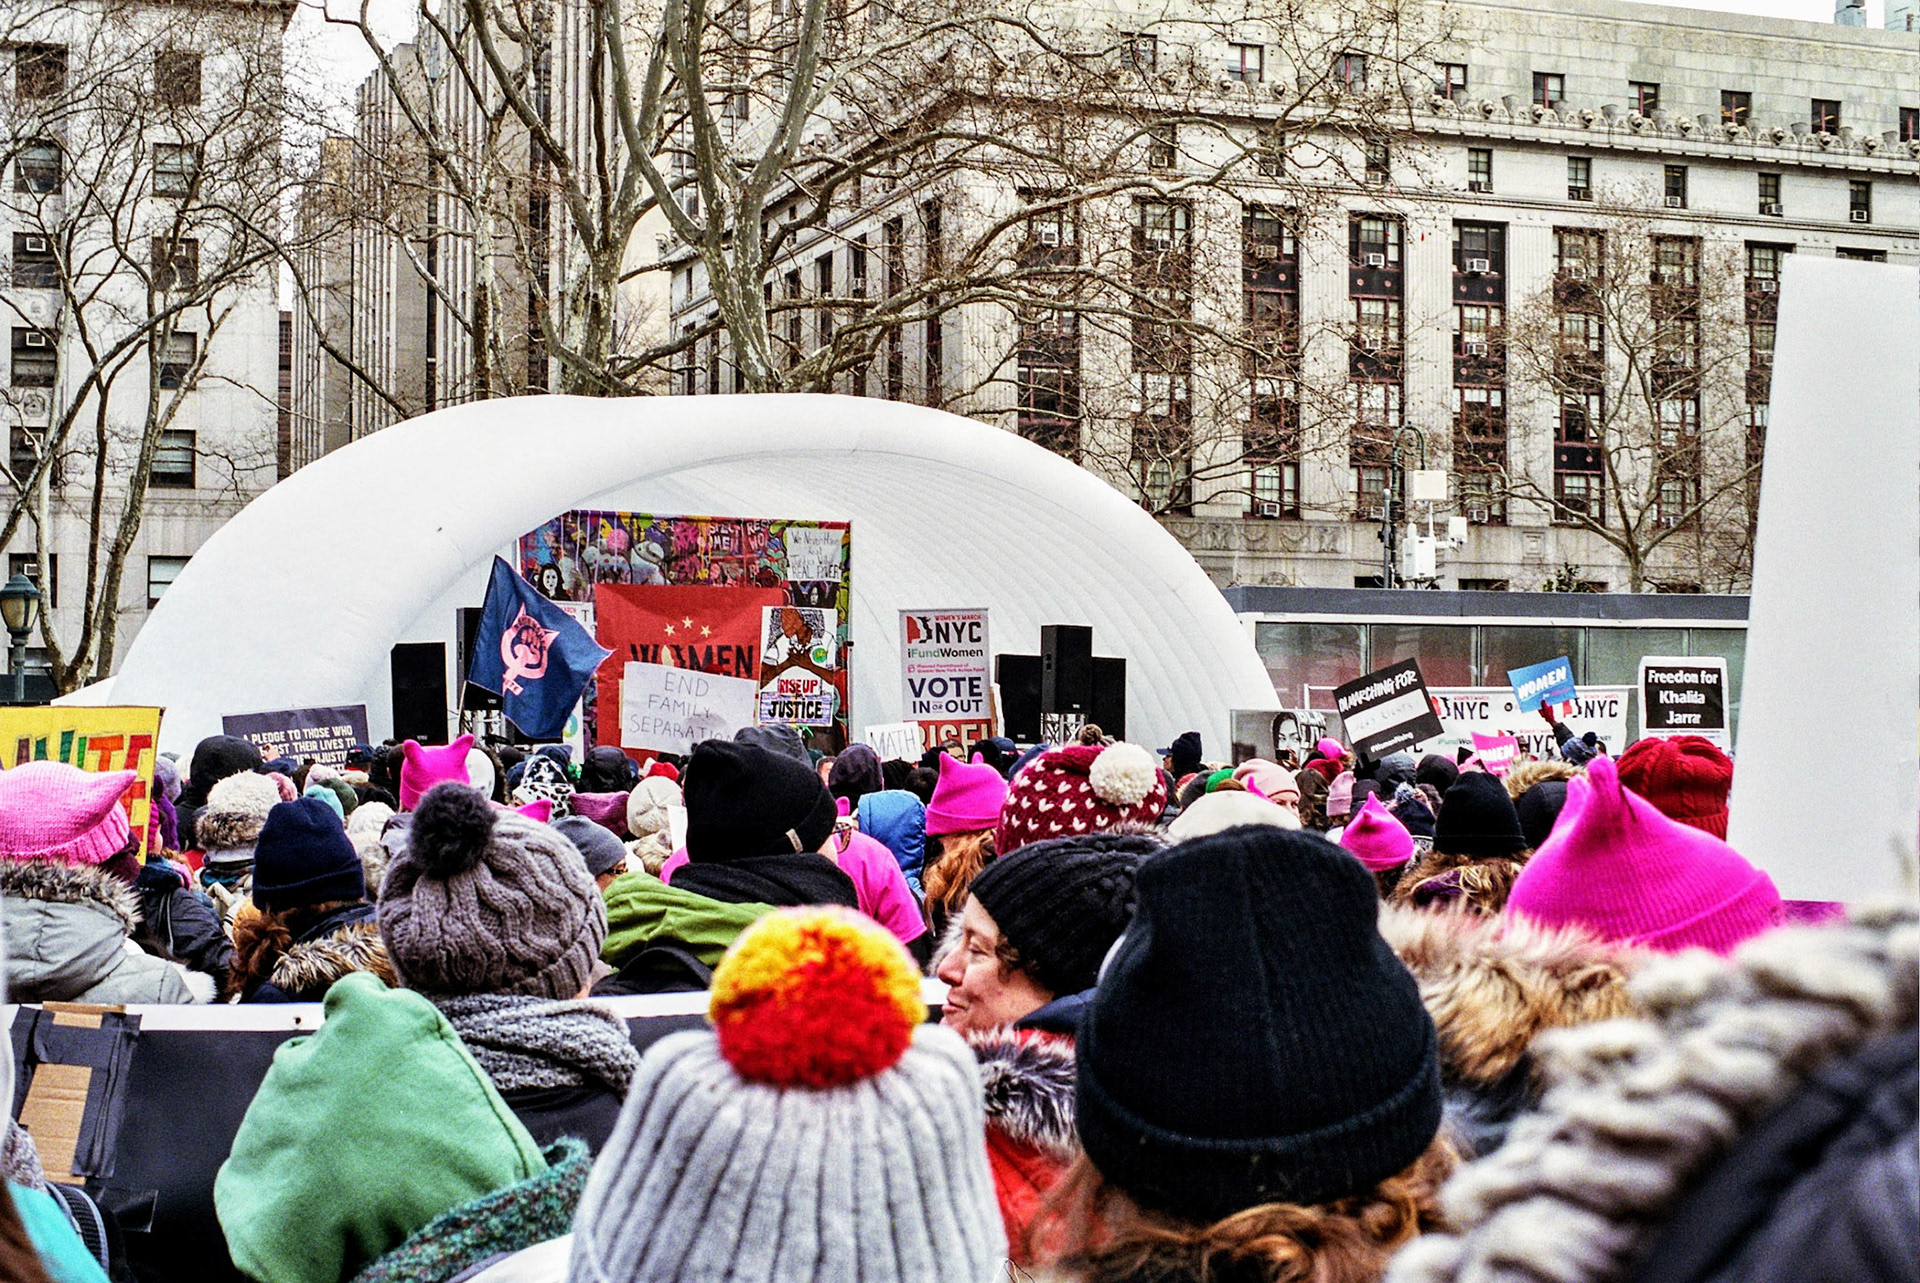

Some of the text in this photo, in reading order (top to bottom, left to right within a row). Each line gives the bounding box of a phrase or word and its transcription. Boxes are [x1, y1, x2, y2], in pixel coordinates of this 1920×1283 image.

[935, 621, 982, 644] NYC
[907, 648, 984, 658] iFundWomen
[664, 671, 710, 698] END
[908, 676, 983, 698] VOTE
[1394, 669, 1418, 690] FOR
[1517, 666, 1567, 699] WOMEN
[1648, 669, 1719, 684] Freedom for
[647, 694, 711, 719] FAMILY
[768, 698, 823, 719] JUSTICE
[912, 699, 983, 714] IN OR OUT
[1453, 701, 1489, 720] NYC
[1584, 699, 1618, 718] NYC
[251, 731, 286, 745] PLEDGE
[287, 729, 301, 741] TO
[302, 727, 330, 739] THOSE
[331, 725, 353, 737] WHO
[292, 740, 318, 753] THEIR
[320, 738, 345, 751] LIVES
[870, 728, 916, 758] MATH
